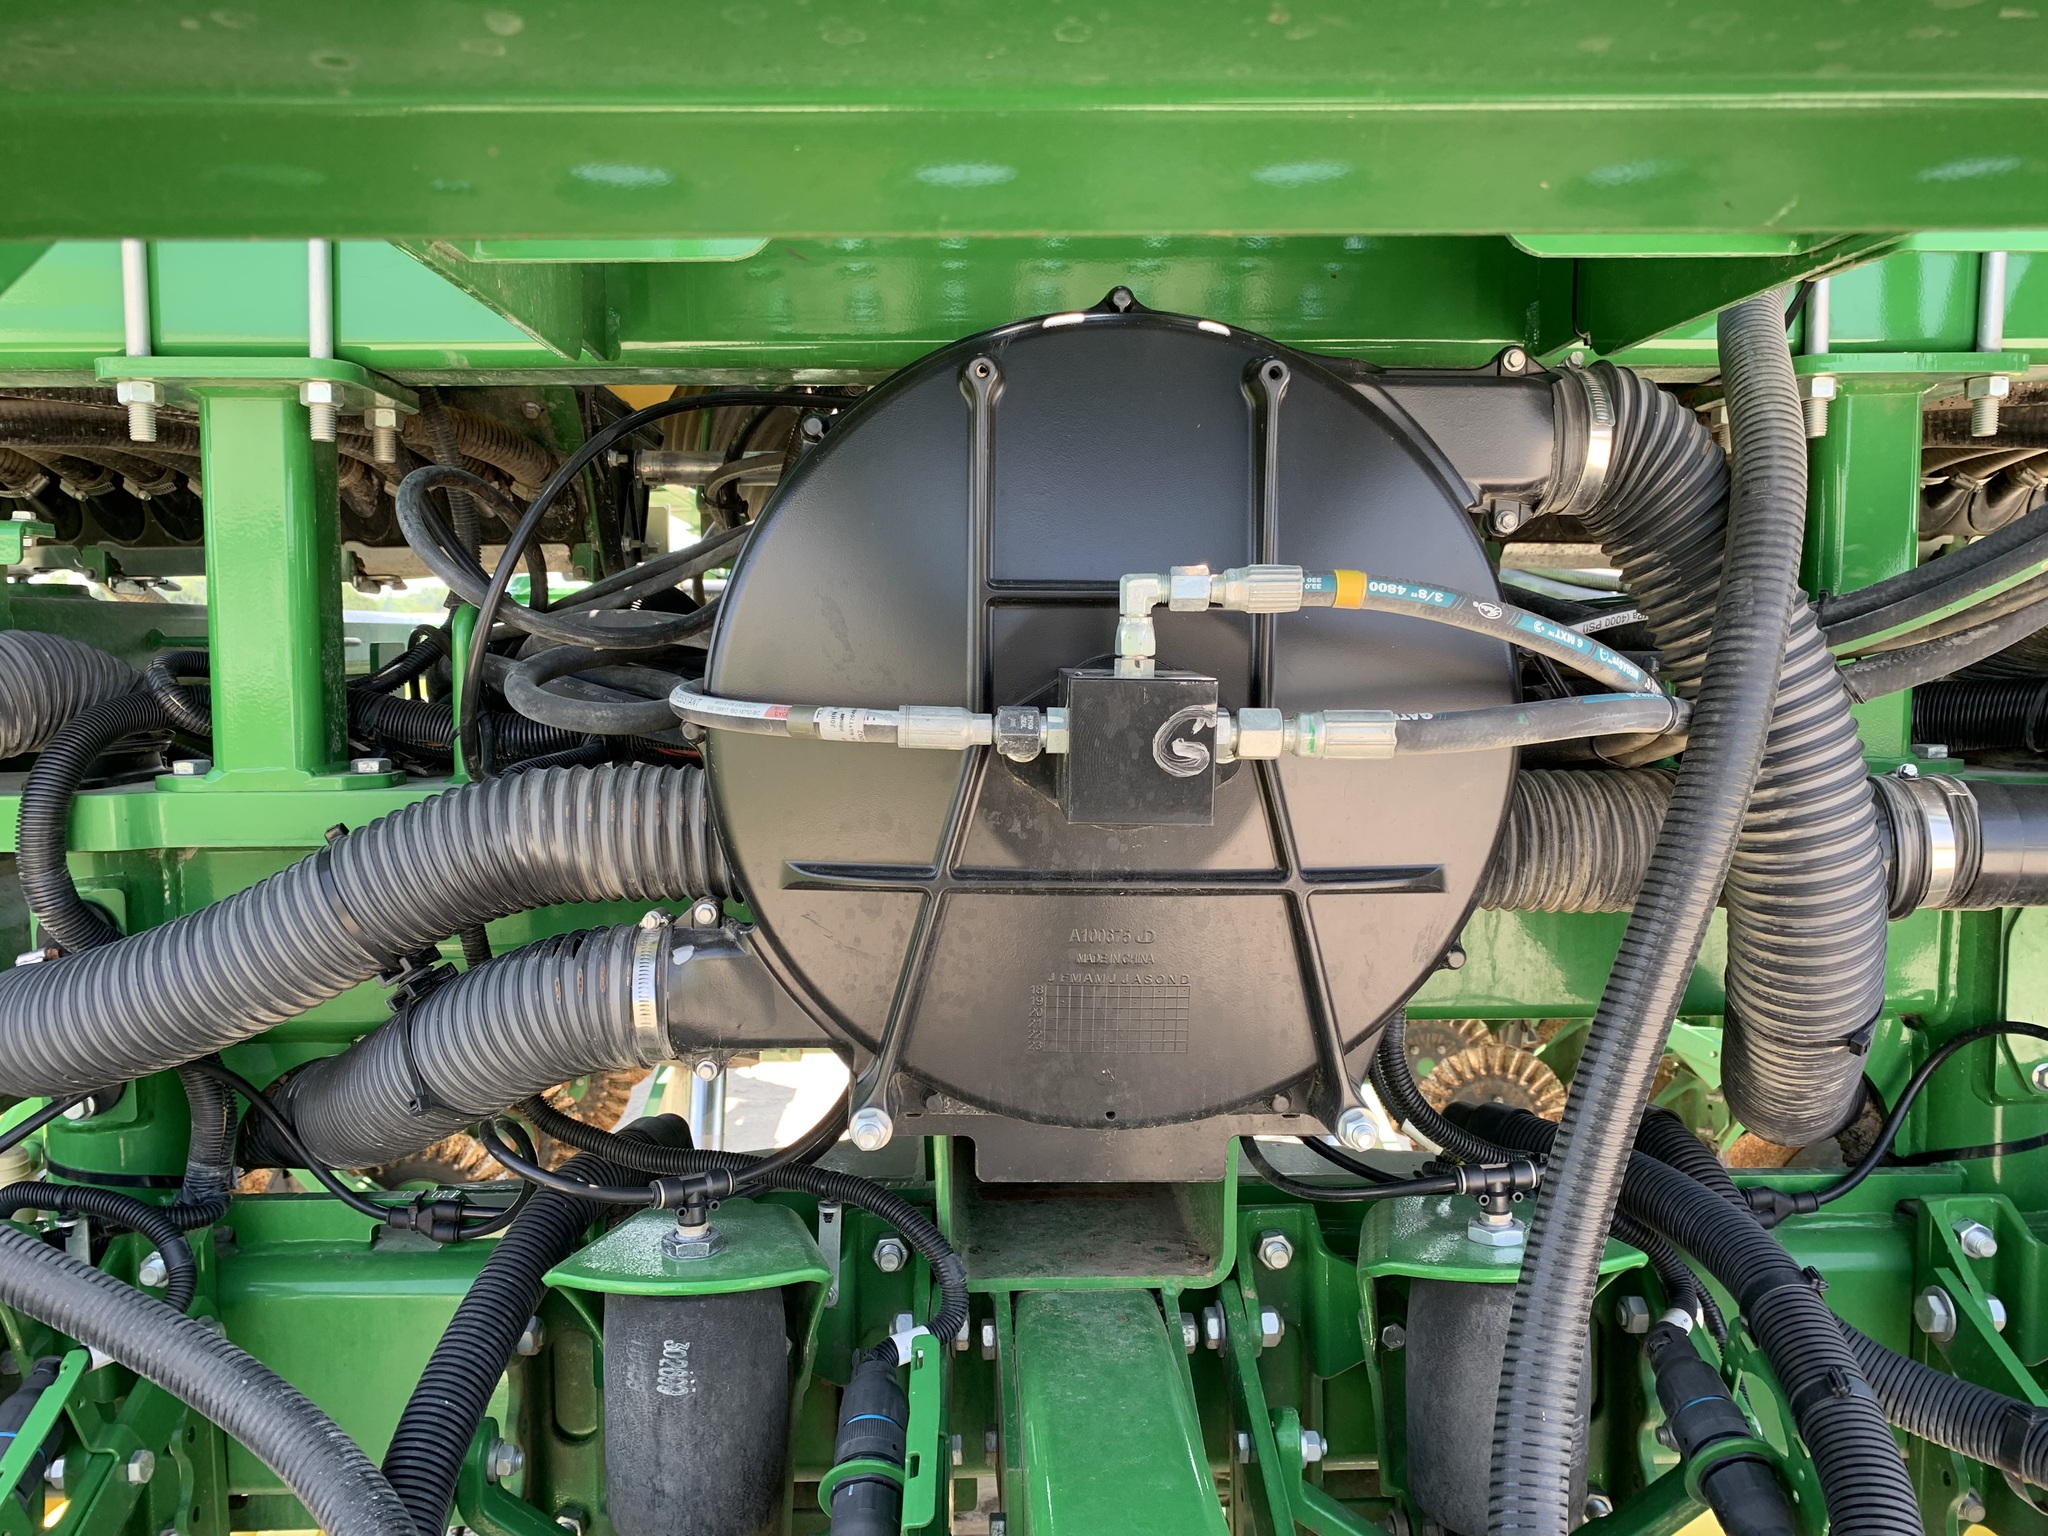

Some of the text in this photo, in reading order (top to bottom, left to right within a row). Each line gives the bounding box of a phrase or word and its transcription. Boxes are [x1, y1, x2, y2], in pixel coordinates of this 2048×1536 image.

[1368, 582, 1407, 595] 4800
[1604, 613, 1630, 627] (4000
[1582, 620, 1602, 633] PSI)
[1577, 639, 1584, 649] 6
[830, 711, 838, 728] JOHN
[1076, 953, 1155, 964] MADE IN CHINA
[1030, 996, 1044, 1006] 19
[1029, 1007, 1044, 1017] 20
[1028, 1018, 1042, 1028] 21
[1028, 1029, 1043, 1040] 22
[1028, 1040, 1043, 1051] 23
